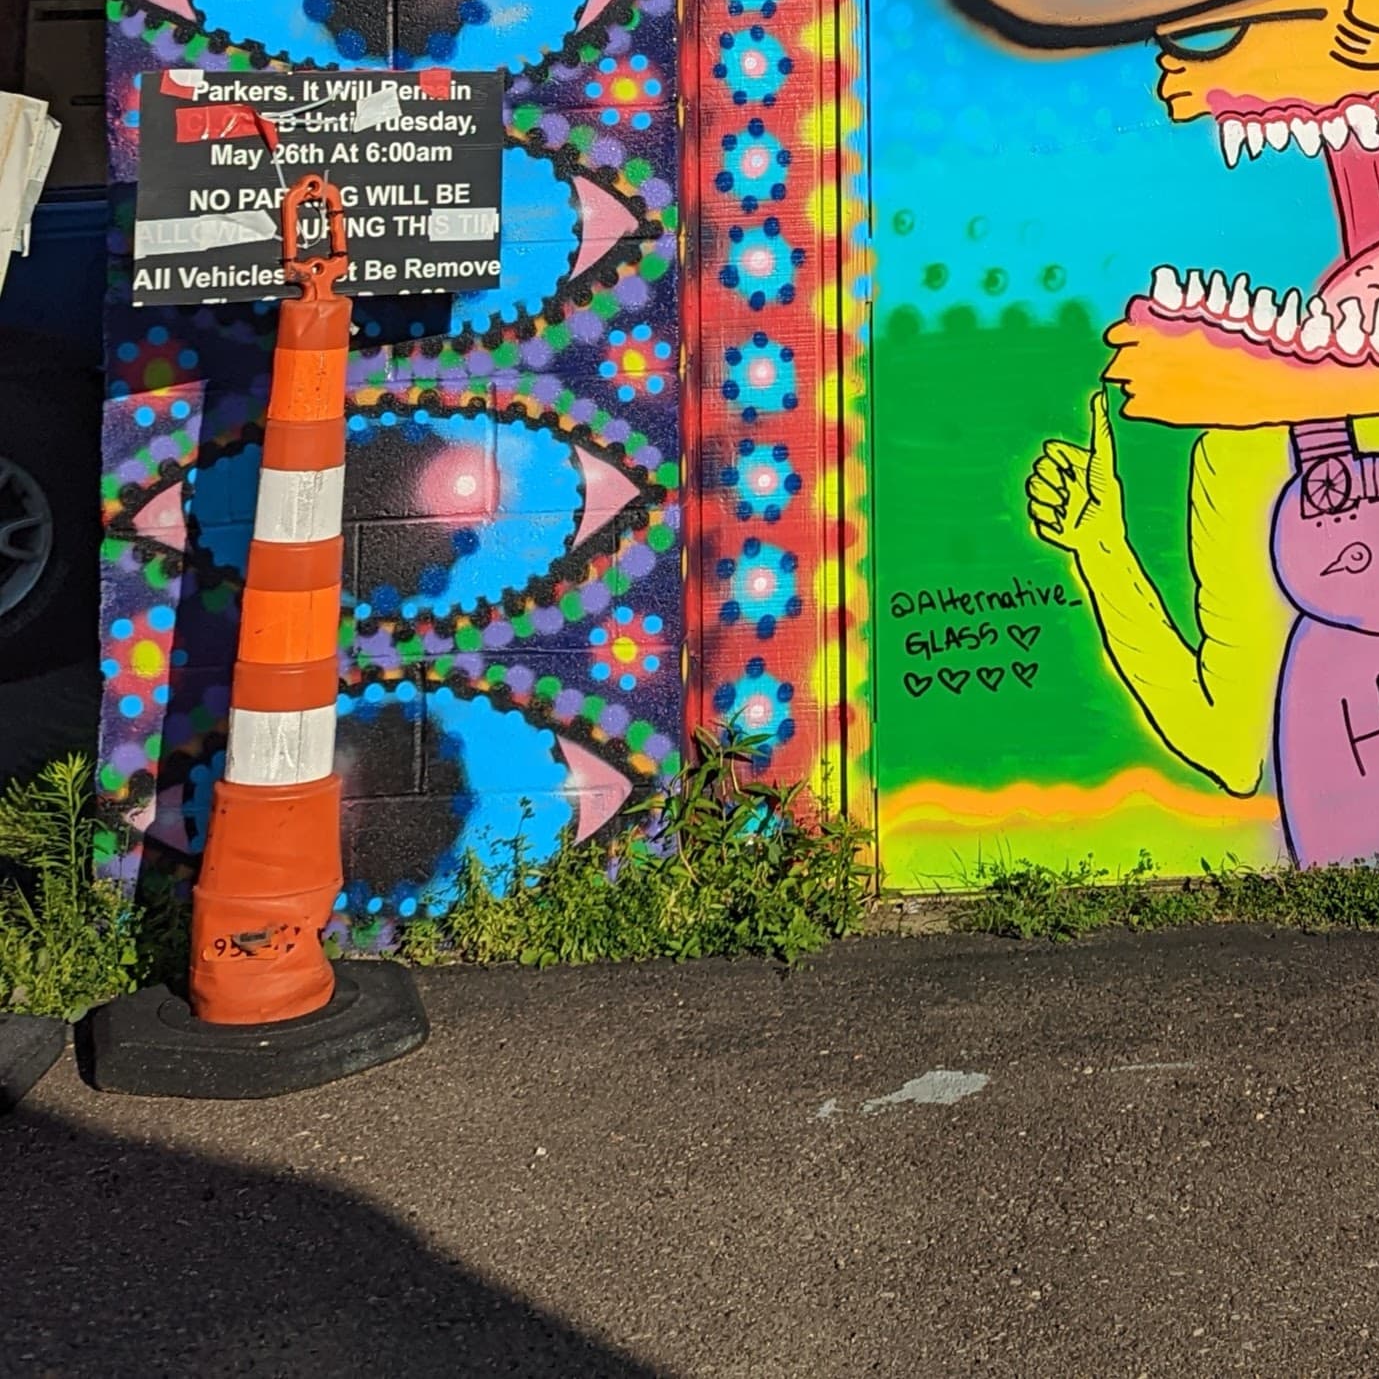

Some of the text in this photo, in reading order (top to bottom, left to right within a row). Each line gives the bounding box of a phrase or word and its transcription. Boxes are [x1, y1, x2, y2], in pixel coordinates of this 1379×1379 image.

[192, 80, 295, 102] Parkers.
[303, 80, 320, 101] It
[325, 80, 372, 101] Will
[305, 111, 355, 133] Unti
[376, 110, 477, 137] uesday,
[210, 141, 453, 171] May 26th At 6:00am
[189, 189, 231, 211] NO
[365, 184, 429, 207] WILL
[436, 183, 471, 205] BE
[132, 268, 171, 291] All
[178, 264, 286, 289] Vehicles
[364, 259, 397, 281] Be
[404, 258, 501, 279] Remove
[904, 621, 999, 661] GLASS
